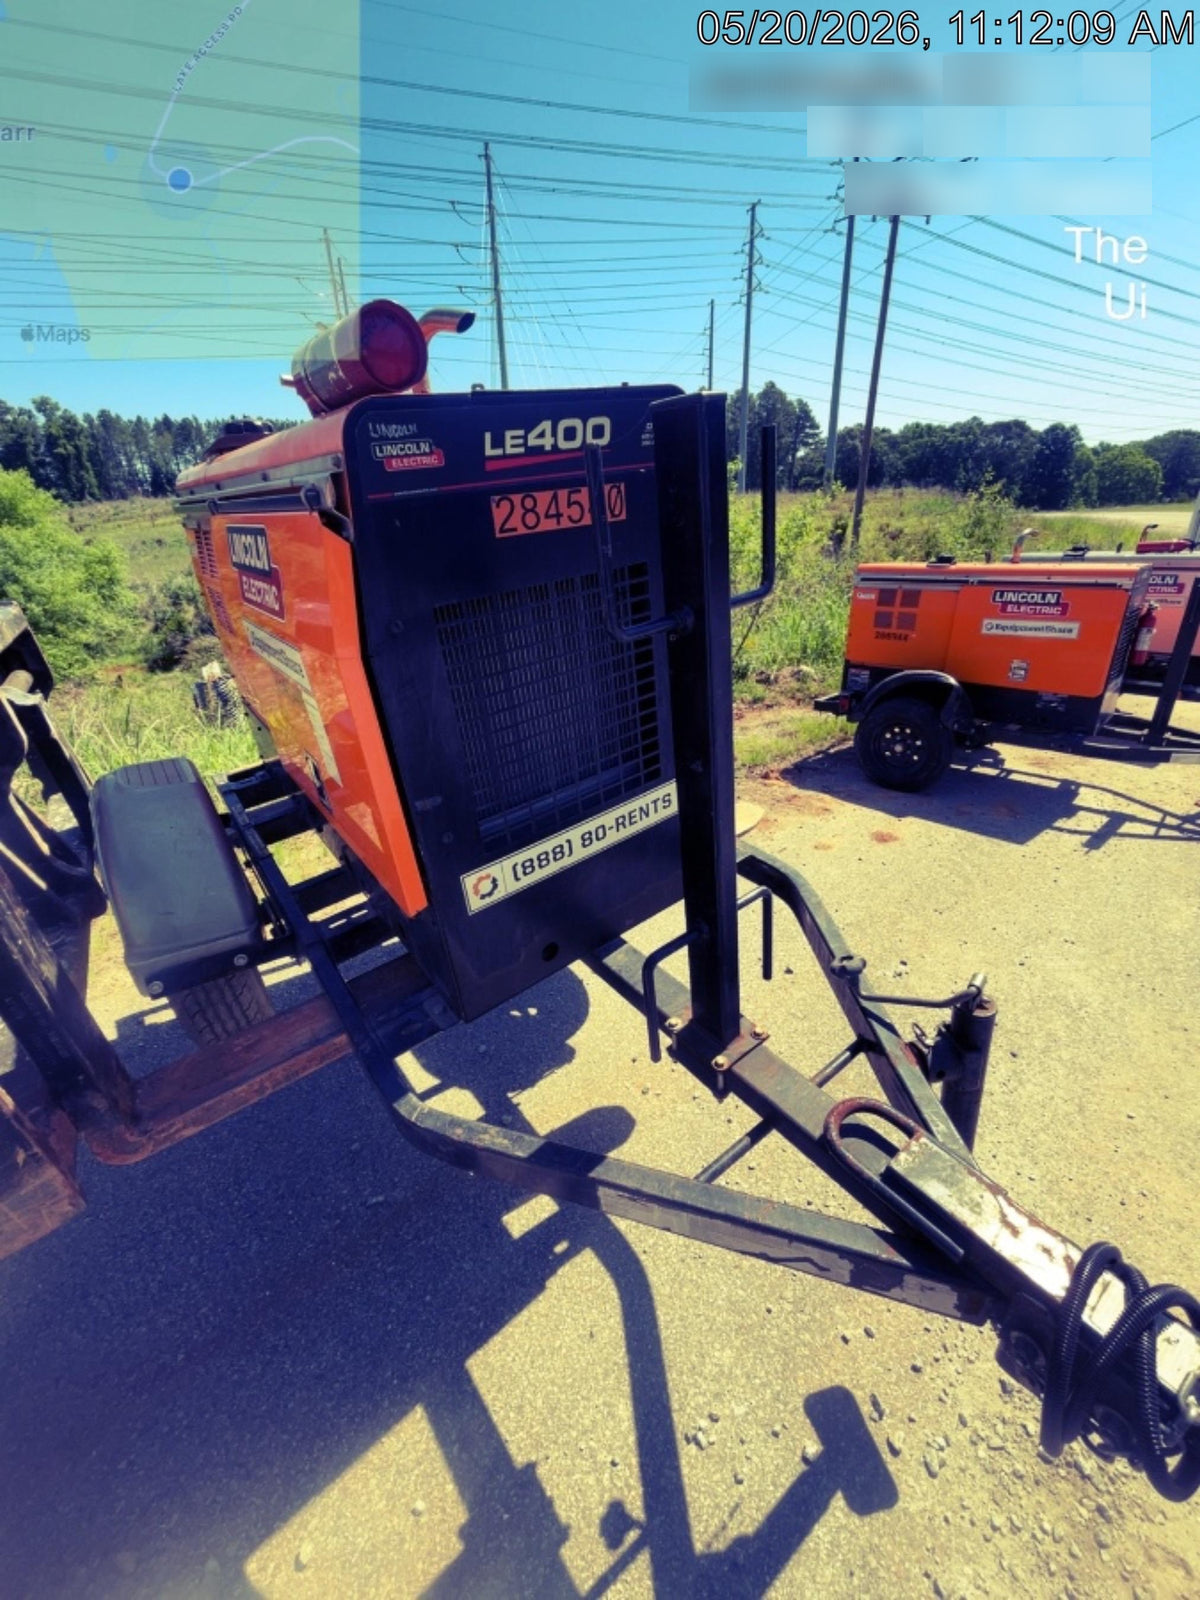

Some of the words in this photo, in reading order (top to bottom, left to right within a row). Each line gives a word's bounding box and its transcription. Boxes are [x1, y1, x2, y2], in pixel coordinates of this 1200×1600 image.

[375, 441, 430, 458] LINCOLN
[484, 416, 611, 457] LE400
[391, 454, 438, 468] ELECTRIC
[495, 484, 623, 534] 28450
[228, 532, 270, 571] LINCOLN
[242, 575, 280, 611] ELECTRIC
[995, 591, 1059, 604] LINCOLN
[1006, 604, 1062, 615] ELECTRIC
[512, 838, 574, 882] (888)
[580, 792, 673, 849] 80-RENTS
